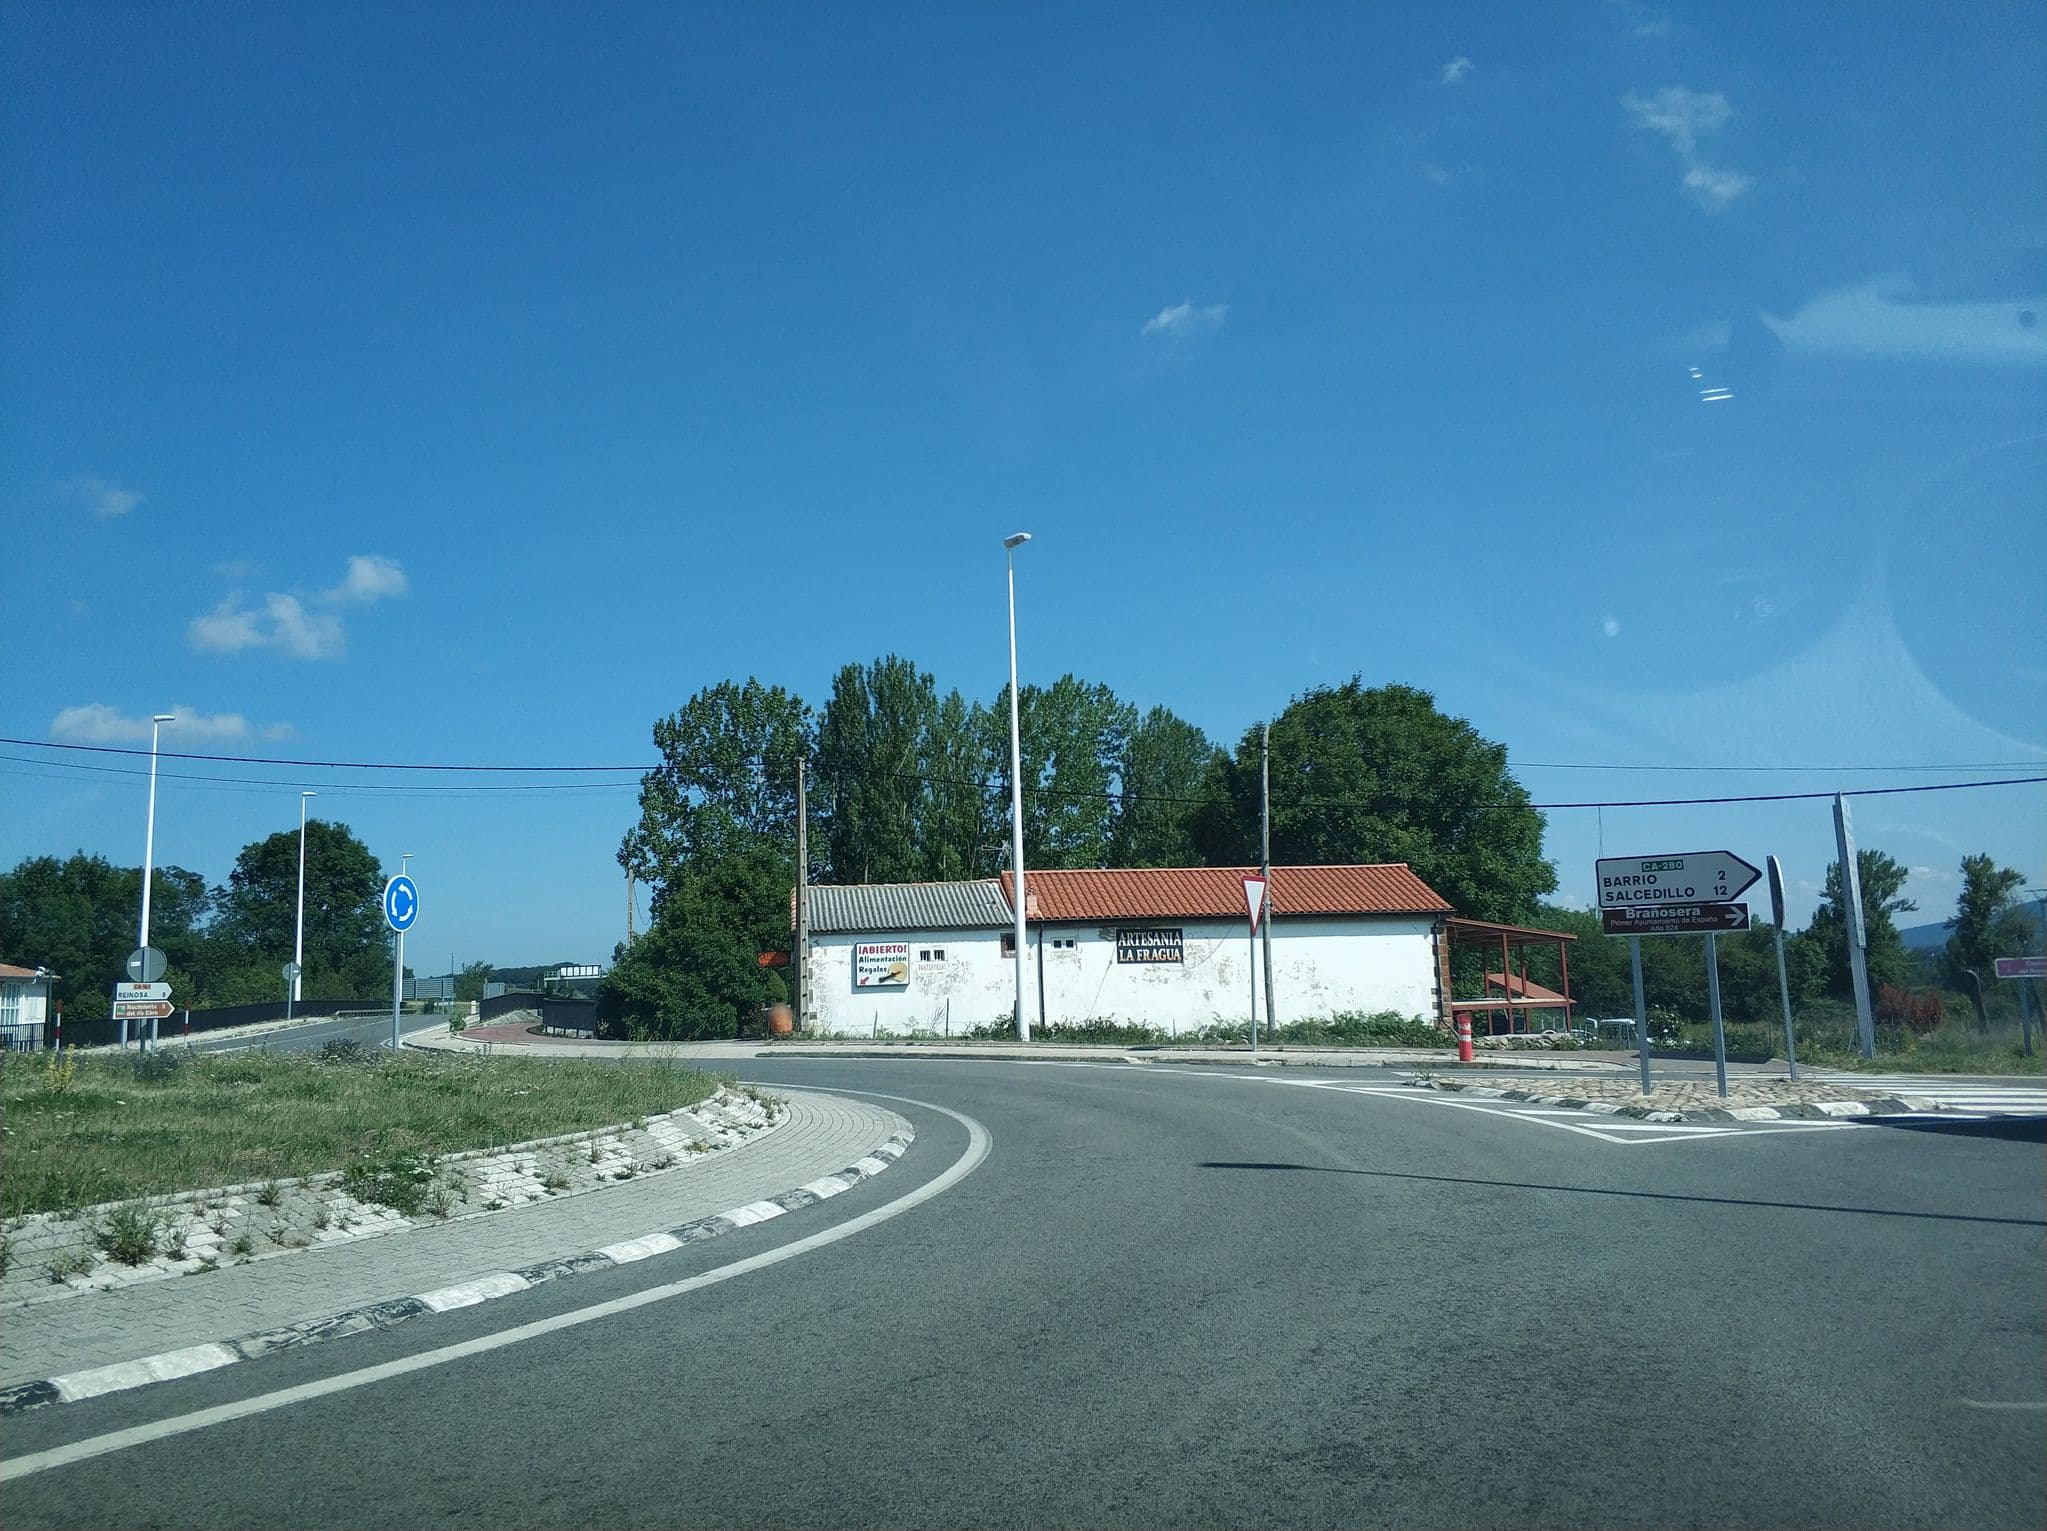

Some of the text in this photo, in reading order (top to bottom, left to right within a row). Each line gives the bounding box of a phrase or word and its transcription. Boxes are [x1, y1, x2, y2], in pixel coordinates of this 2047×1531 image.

[1604, 870, 1726, 887] BARRIO 2
[1605, 885, 1728, 901] SALCEDILLO 12
[1626, 907, 1701, 919] Brañosera
[1691, 915, 1718, 925] España
[1118, 932, 1182, 946] ARTESANIA
[859, 955, 906, 963] Alimentación
[1119, 948, 1182, 961] LA FRAGUA
[859, 966, 887, 974] Regalos
